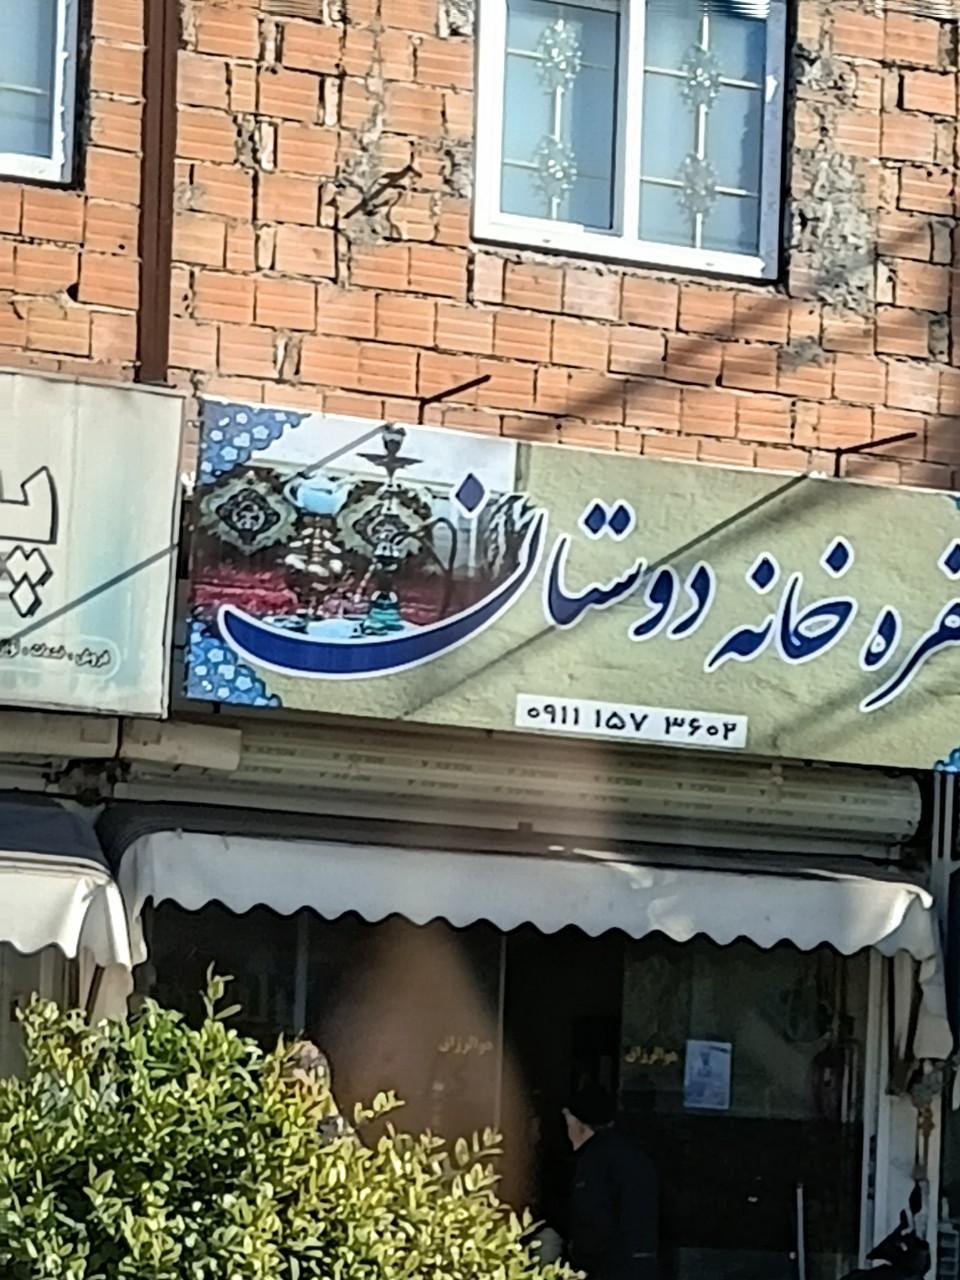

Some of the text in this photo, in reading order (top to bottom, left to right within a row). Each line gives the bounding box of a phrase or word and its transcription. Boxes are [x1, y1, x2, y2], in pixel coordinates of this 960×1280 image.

[218, 472, 716, 678] دوستان
[704, 537, 857, 672] خانه
[527, 703, 580, 726] ۰۹۱۱
[594, 708, 649, 732] ۱۵۷
